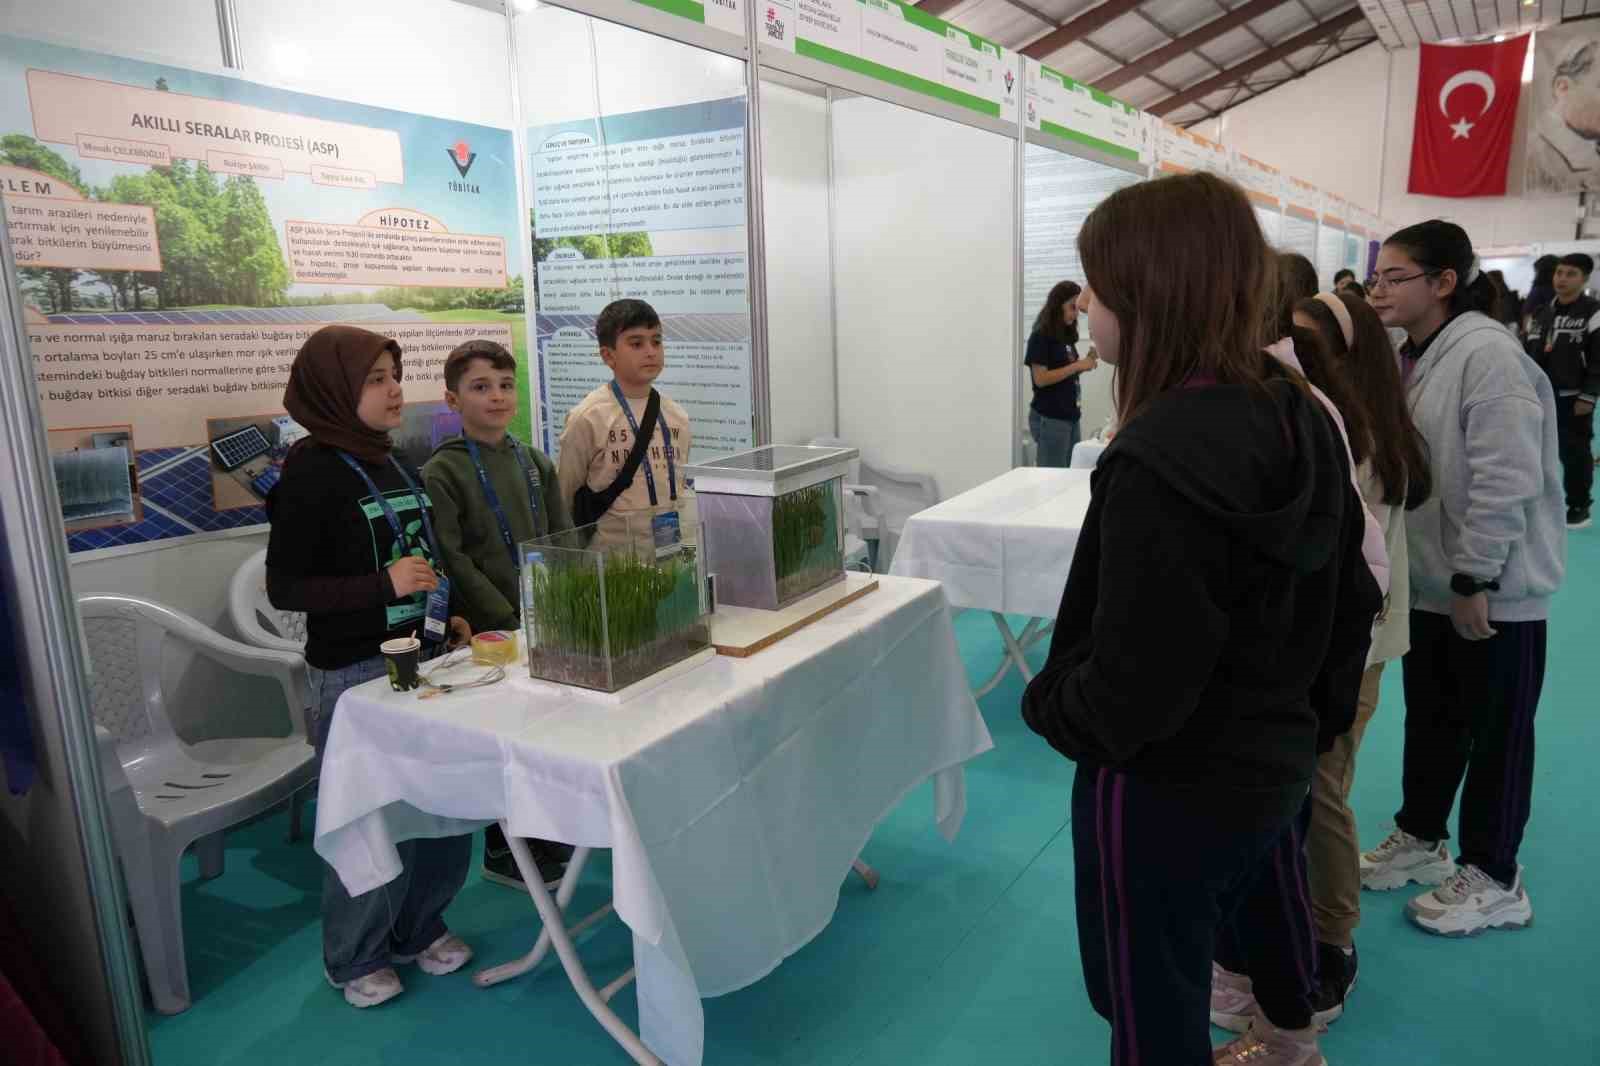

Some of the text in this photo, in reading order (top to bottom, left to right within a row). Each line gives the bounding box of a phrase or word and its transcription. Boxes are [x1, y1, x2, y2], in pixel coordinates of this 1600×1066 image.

[131, 113, 340, 159] AKILLI SERALAR PROJESİ (ASP)
[448, 181, 480, 194] TÜBİTAK
[12, 204, 148, 225] tarım arazileri nedeniyle
[380, 214, 430, 230] HİPOTEZ
[60, 222, 81, 236] için
[86, 224, 150, 239] yenilenebilir
[38, 236, 87, 250] bitkilerin
[91, 240, 153, 254] büyümesini
[45, 334, 60, 343] ve
[64, 332, 106, 343] normal
[109, 332, 134, 345] ışığa
[136, 332, 170, 342] maruz
[172, 330, 217, 342] bırakılan
[220, 329, 259, 341] seradaki
[262, 328, 293, 342] buğday
[44, 352, 99, 362] ortalama
[103, 350, 141, 364] boyları
[144, 350, 158, 360] 25
[161, 349, 186, 360] cm'e
[188, 348, 233, 361] ulaşırken
[236, 350, 256, 358] mor
[258, 348, 274, 360] ışık
[402, 344, 420, 354] ğday
[106, 368, 146, 384] buğday
[148, 366, 189, 379] bitkileri
[191, 365, 254, 378] normallerine
[256, 364, 276, 376] göre
[277, 363, 292, 374] %3
[48, 389, 94, 402] buğday
[98, 386, 132, 399] bitkisi
[136, 385, 162, 400] diğer
[168, 383, 210, 396] seradaki
[213, 382, 248, 394] buğday
[608, 428, 628, 442] 85
